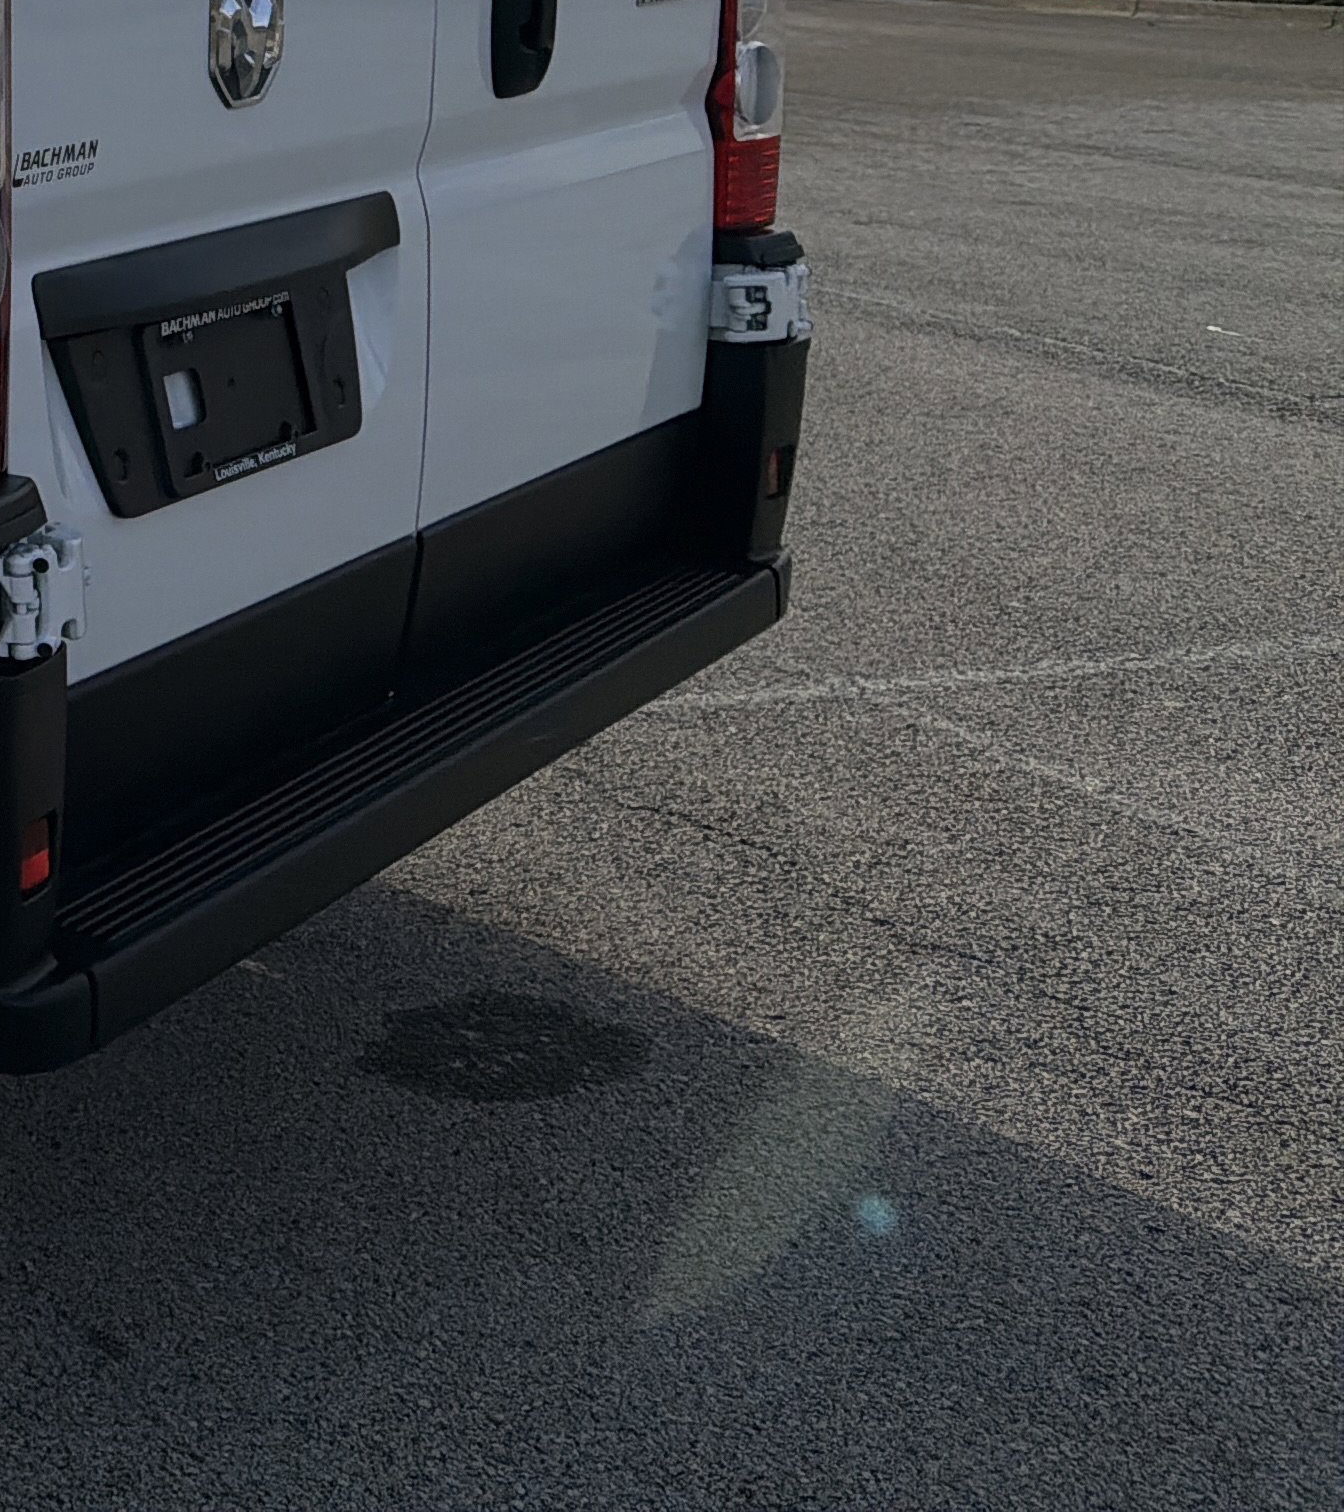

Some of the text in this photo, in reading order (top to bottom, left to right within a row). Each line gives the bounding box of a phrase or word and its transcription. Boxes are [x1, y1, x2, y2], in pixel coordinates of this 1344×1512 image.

[20, 139, 98, 171] BACHMAN
[24, 163, 94, 185] AUTO GROUP
[161, 310, 216, 337] BACHMAN
[217, 304, 241, 320] AUTO
[257, 442, 297, 465] Kentucky
